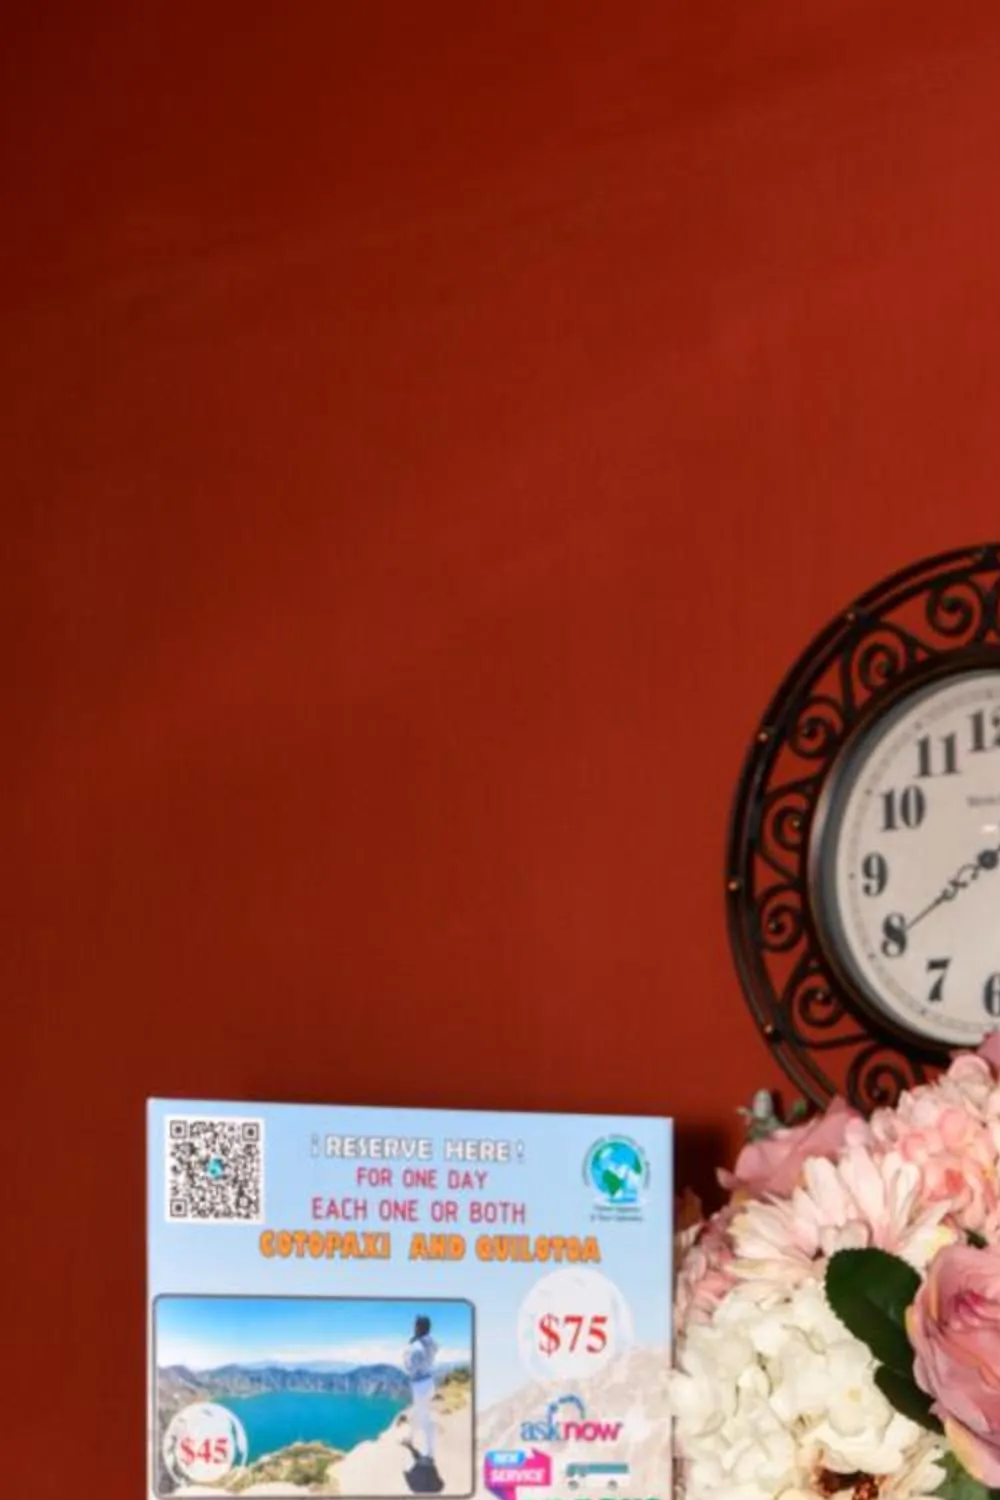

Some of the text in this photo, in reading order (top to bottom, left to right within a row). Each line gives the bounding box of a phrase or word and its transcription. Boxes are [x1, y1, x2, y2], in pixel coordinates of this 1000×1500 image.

[913, 734, 960, 778] 11
[880, 785, 926, 832] 10
[861, 852, 888, 896] 9
[882, 913, 907, 957] 8
[926, 958, 951, 1002] 7
[325, 1135, 433, 1161] RESERVE
[443, 1138, 510, 1162] HERE
[356, 1167, 488, 1190] FOR ONE DAY
[311, 1197, 526, 1225] EACH ONE OR BOTH
[259, 1229, 391, 1260] COTOPAXI
[409, 1232, 466, 1262] AND
[538, 1313, 608, 1356] $75
[180, 1439, 227, 1466] $45
